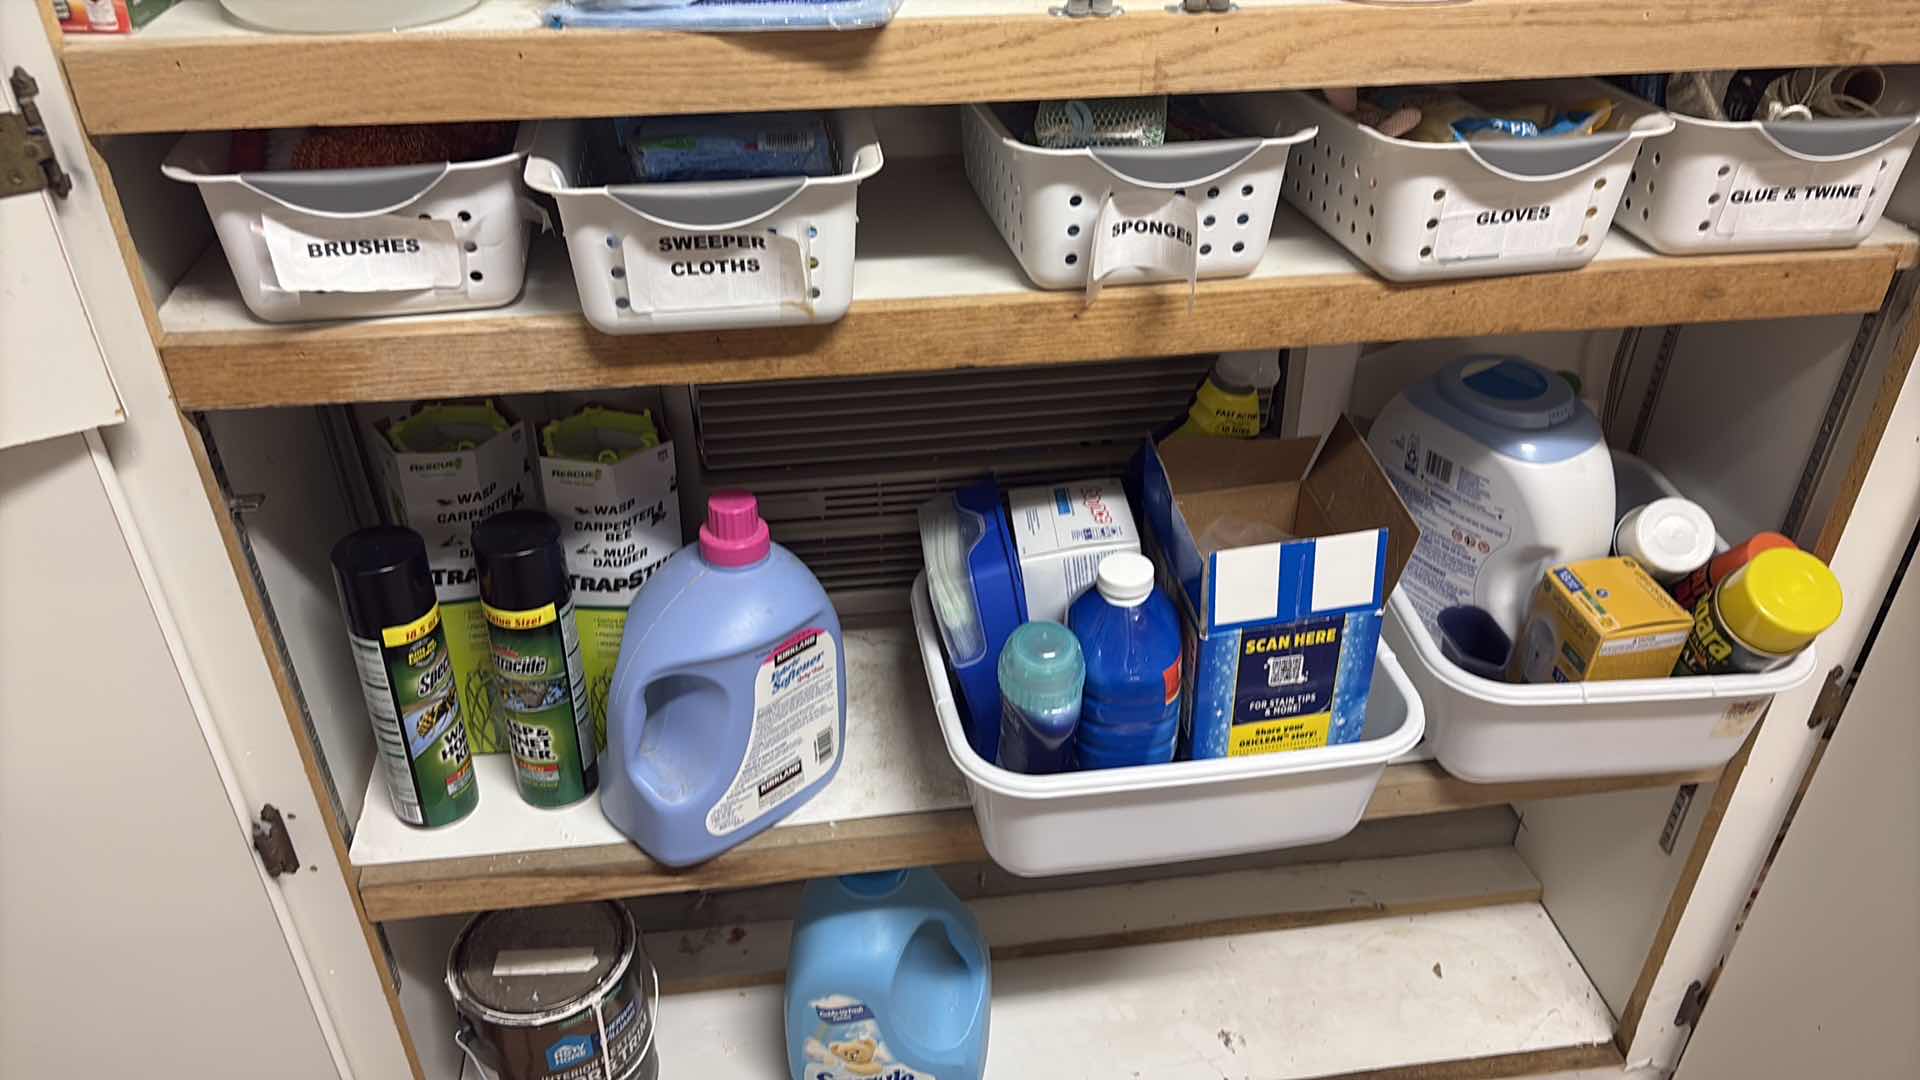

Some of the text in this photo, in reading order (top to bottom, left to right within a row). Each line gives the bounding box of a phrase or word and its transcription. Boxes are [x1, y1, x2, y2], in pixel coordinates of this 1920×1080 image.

[1730, 184, 1863, 205] GLUE & TWINE
[1476, 206, 1551, 226] GLOVES
[659, 234, 767, 252] SWEEPER
[1112, 219, 1193, 247] SPONGES
[307, 238, 421, 258] BRUSHES
[670, 258, 761, 277] CLOTHS
[457, 482, 497, 505] WASP
[594, 498, 636, 515] WASP
[574, 506, 655, 531] CARPENTER
[605, 529, 632, 542] BEE
[593, 547, 648, 568] DAUBER
[604, 544, 636, 558] MUD
[776, 635, 815, 663] KIRKLAND
[1245, 628, 1337, 655] SCAN HERE
[1249, 692, 1317, 712] FOR STAIN TIPS
[1273, 703, 1301, 716] MORE!
[760, 763, 800, 794] KIRKLAND
